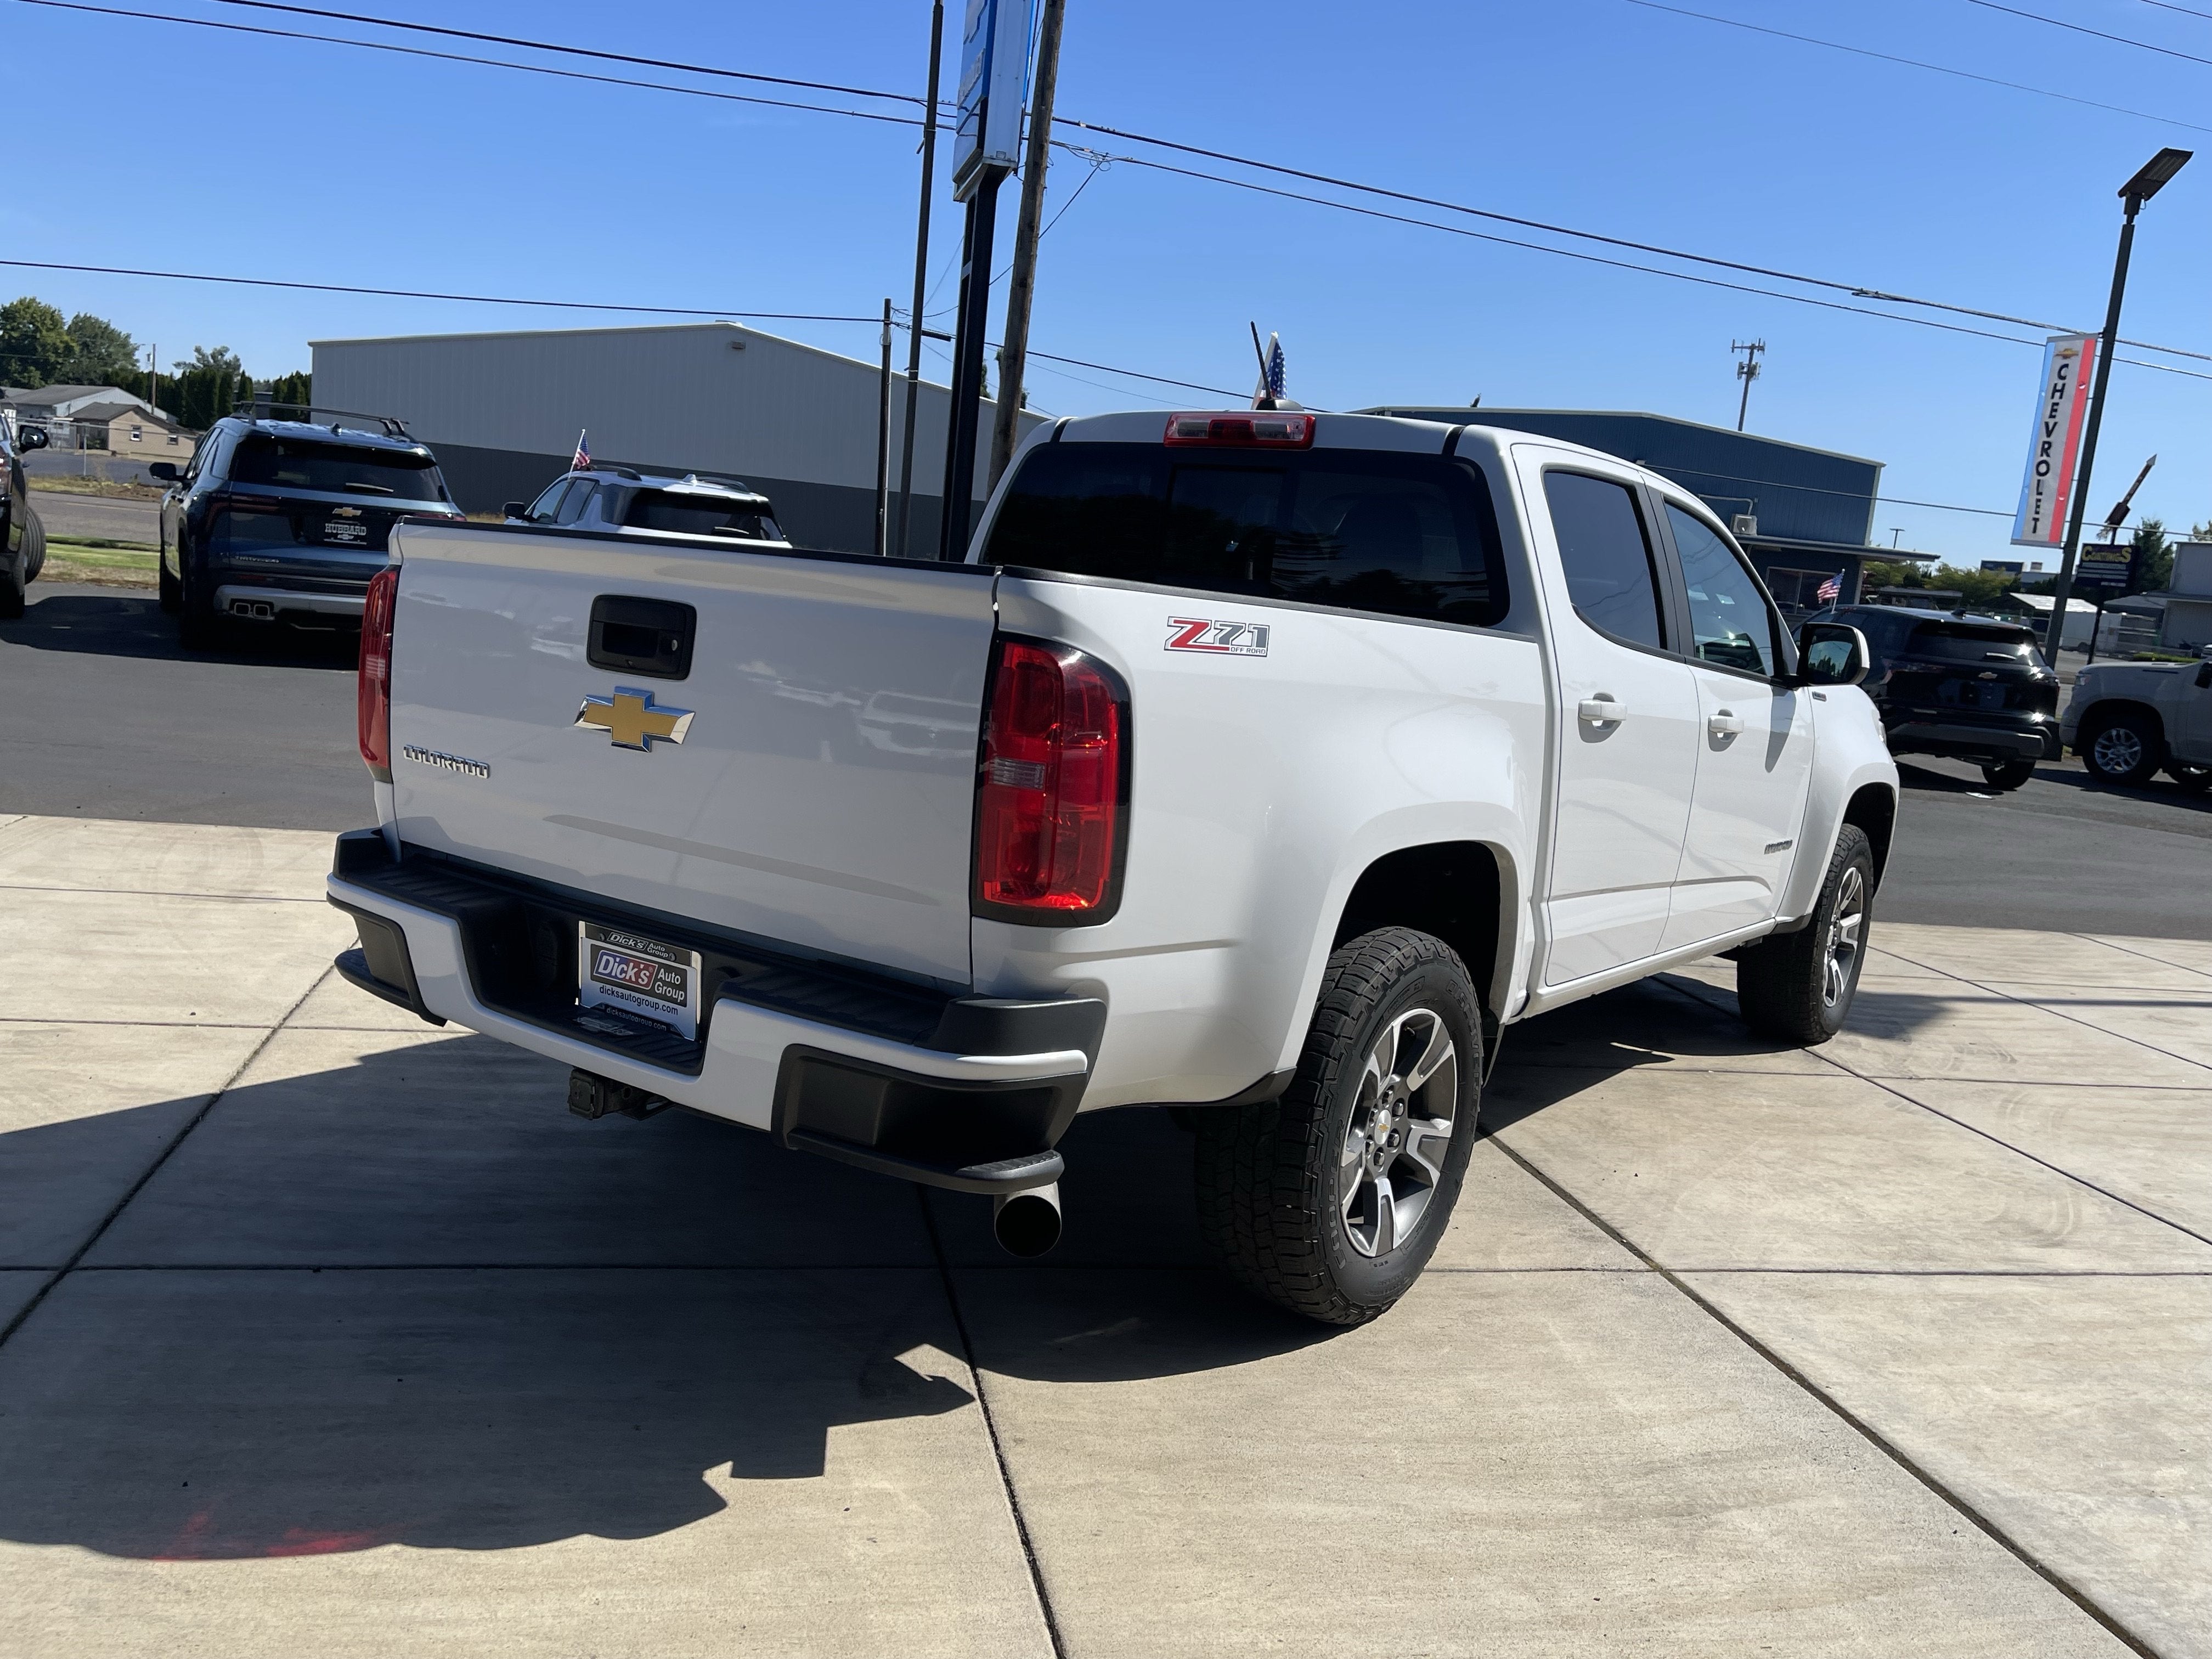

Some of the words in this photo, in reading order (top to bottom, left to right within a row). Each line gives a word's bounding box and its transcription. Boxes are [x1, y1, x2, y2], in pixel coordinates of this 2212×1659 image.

[2032, 364, 2069, 534] CHEVROLET
[325, 523, 367, 536] HUBBARD
[1164, 616, 1270, 658] Z71
[403, 744, 492, 779] COLORADO
[610, 933, 645, 949] Dick's
[648, 943, 666, 952] Auto
[647, 947, 669, 958] Group
[597, 955, 650, 985] Dick's
[657, 968, 681, 985] Auto
[599, 985, 679, 1015] dicksautogroup.com
[654, 981, 685, 1003] Group
[606, 1006, 667, 1031] dicksautogroupcom
[1328, 1118, 1346, 1269] COOPER
